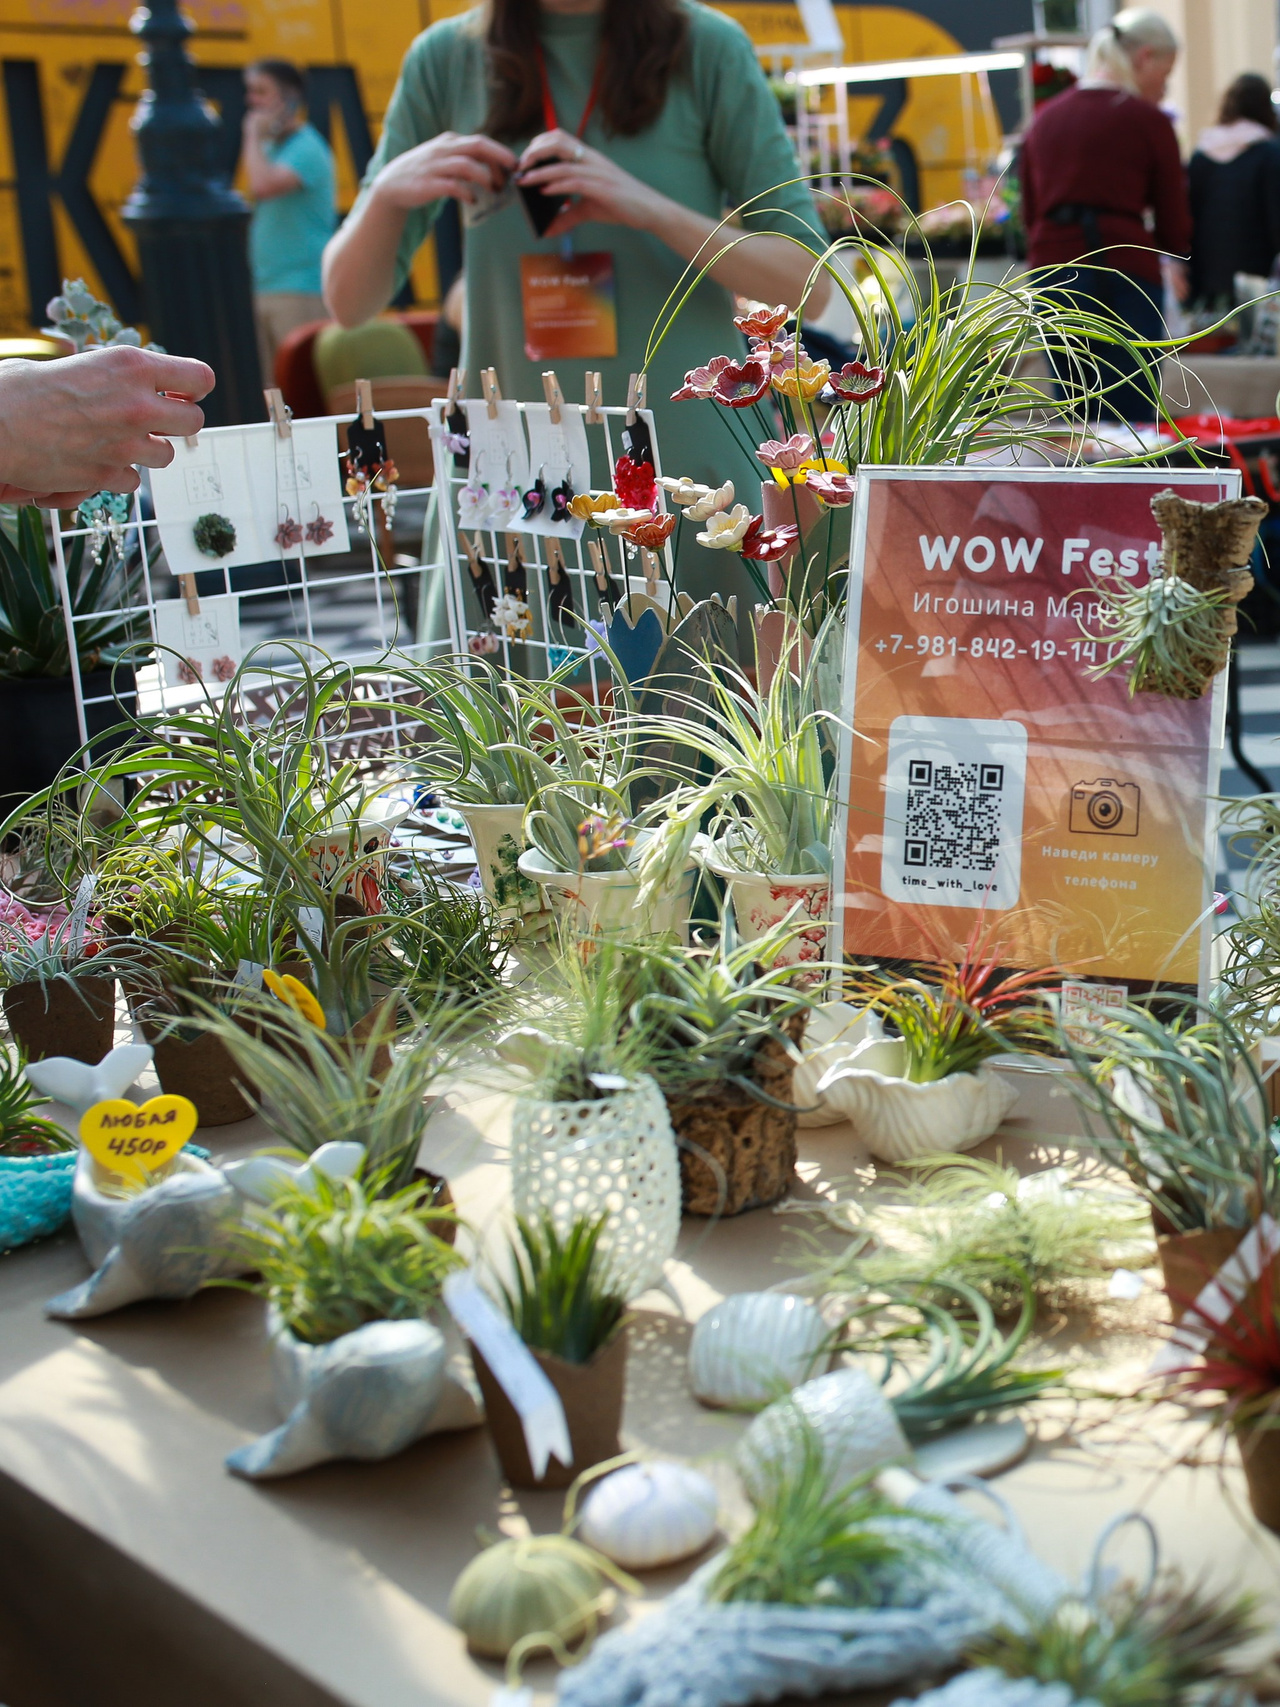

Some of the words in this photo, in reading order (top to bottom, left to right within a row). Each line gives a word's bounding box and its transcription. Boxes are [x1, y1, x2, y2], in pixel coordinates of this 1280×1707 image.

[918, 535, 1044, 574] WOW
[1061, 537, 1165, 578] Fest
[913, 591, 1035, 618] Игошина
[874, 633, 1098, 663] +7-981-842-19-14
[1041, 845, 1098, 864] Наведи
[1101, 850, 1160, 868] камеру
[901, 875, 998, 893] time_with_love
[1064, 875, 1138, 893] телефона
